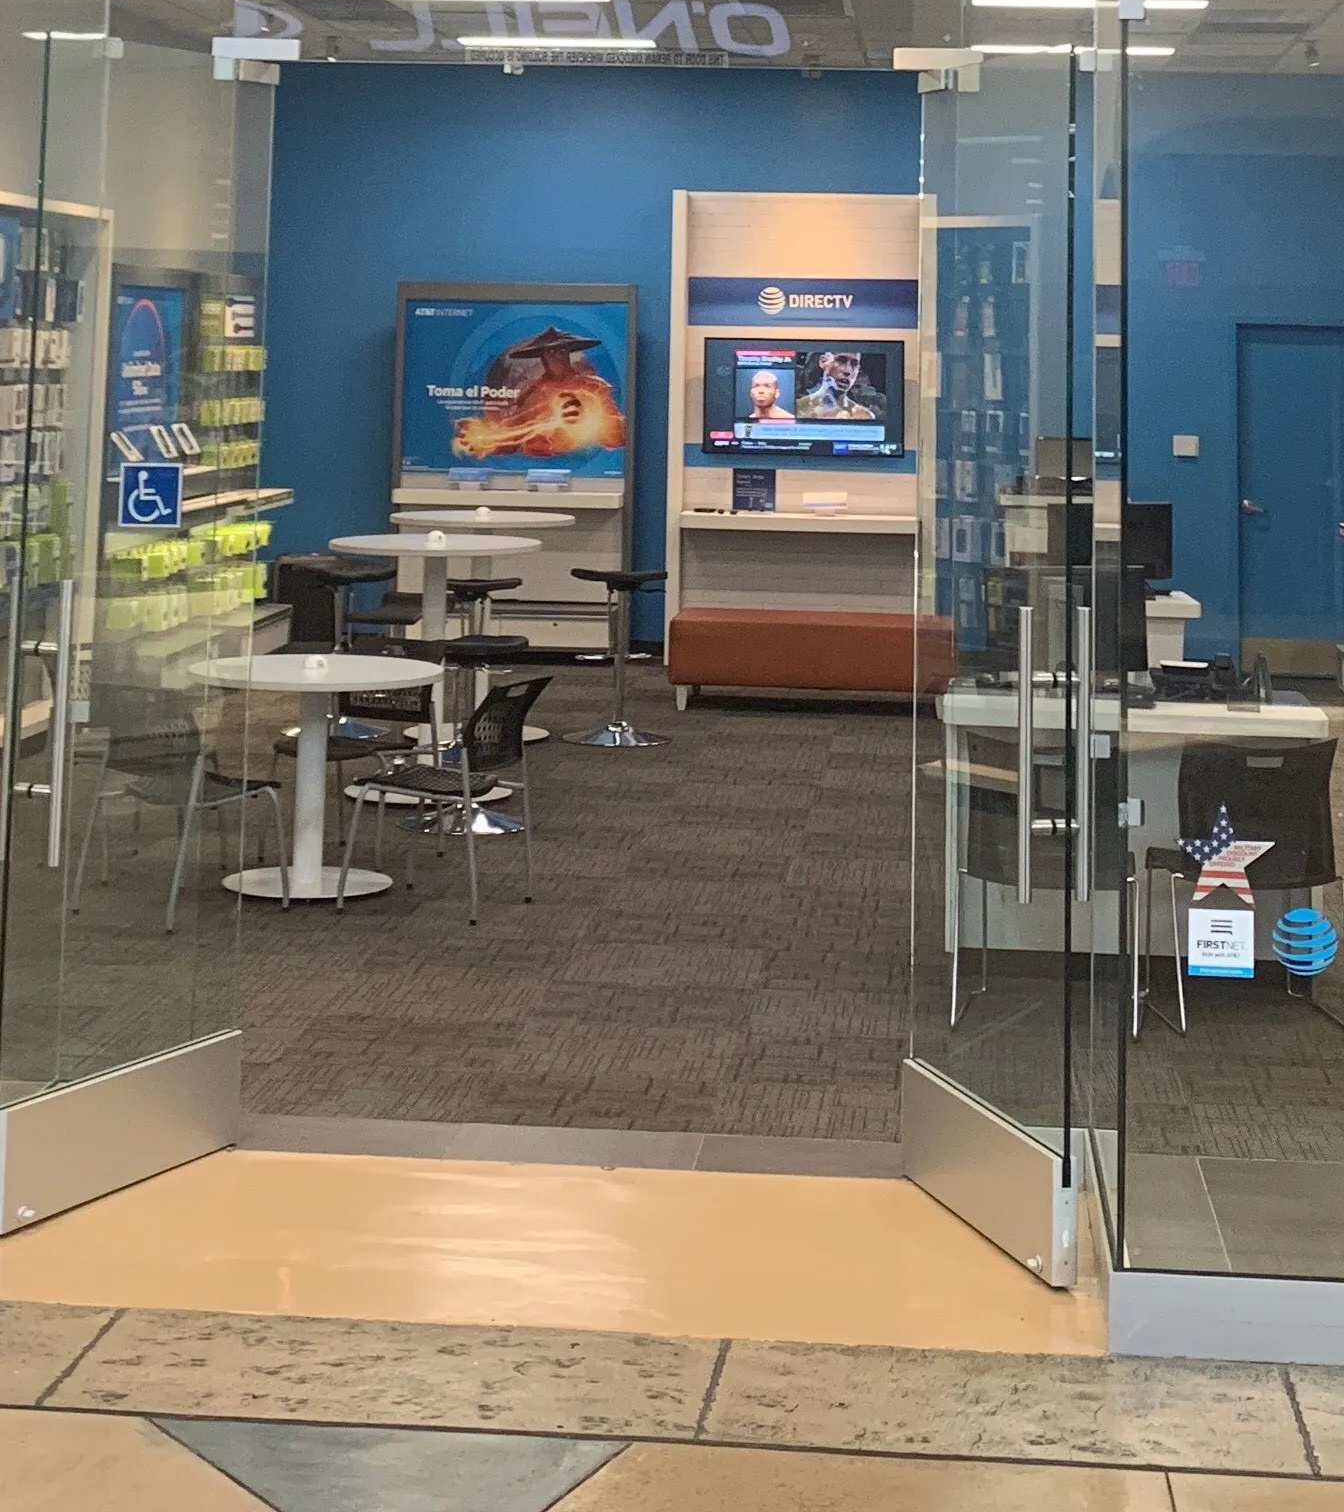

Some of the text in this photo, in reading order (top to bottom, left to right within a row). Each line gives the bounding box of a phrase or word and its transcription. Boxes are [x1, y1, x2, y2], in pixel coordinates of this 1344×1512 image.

[789, 294, 854, 309] DIRECTV
[427, 384, 521, 398] Toma el Poder
